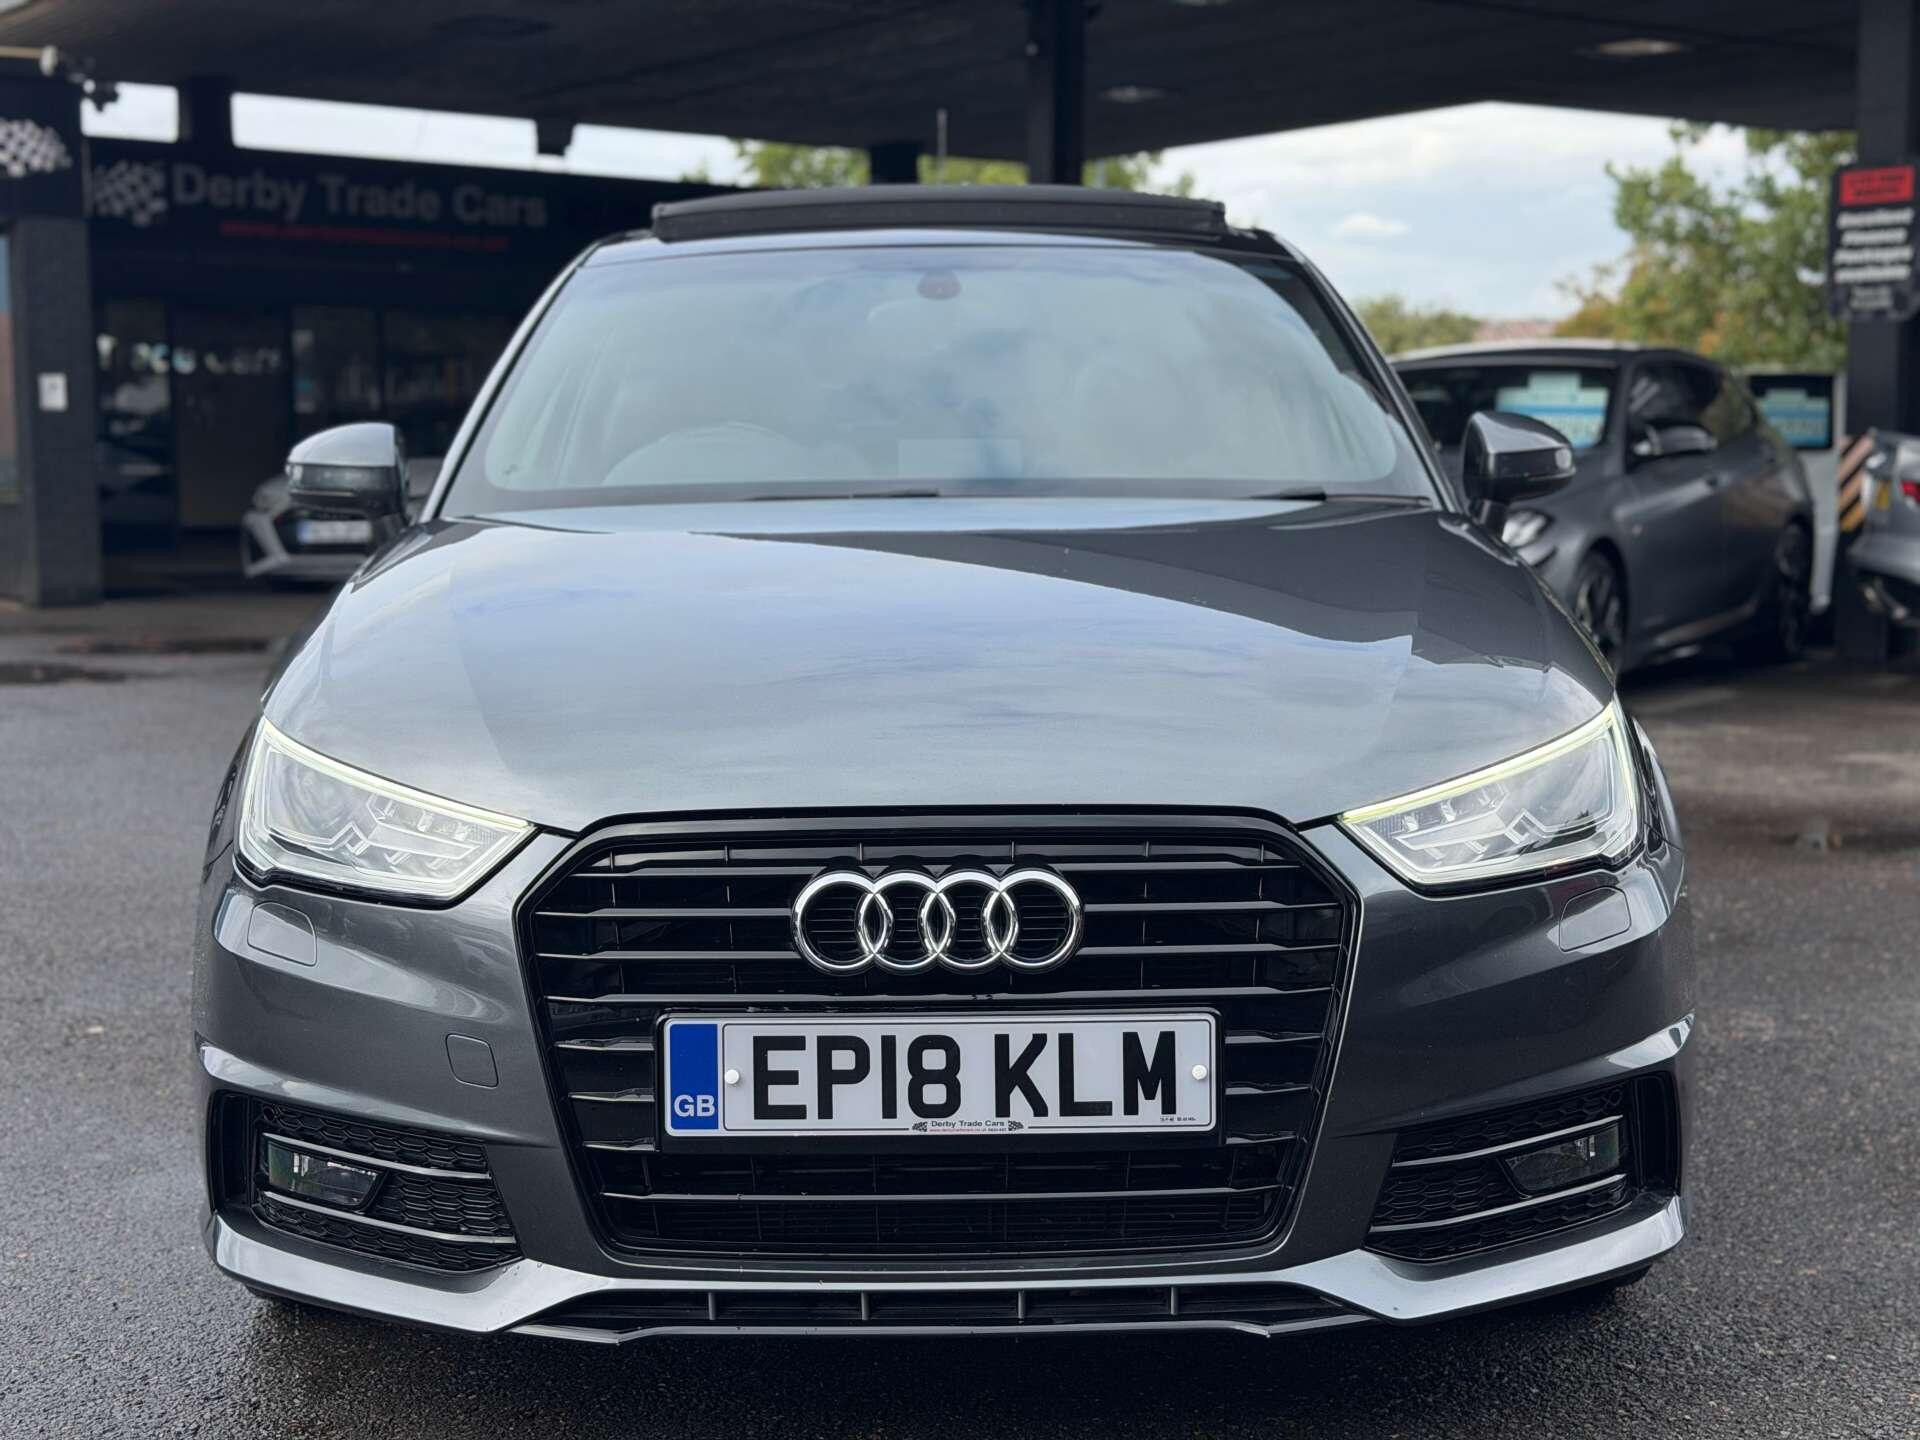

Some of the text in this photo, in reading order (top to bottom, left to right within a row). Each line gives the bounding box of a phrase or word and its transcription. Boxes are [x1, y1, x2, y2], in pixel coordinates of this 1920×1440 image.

[172, 163, 548, 227] Derby Trade Cars
[752, 1030, 1177, 1121] EP18 KLM
[674, 1094, 716, 1118] GB
[931, 1120, 956, 1129] Derby
[958, 1120, 983, 1128] Trade
